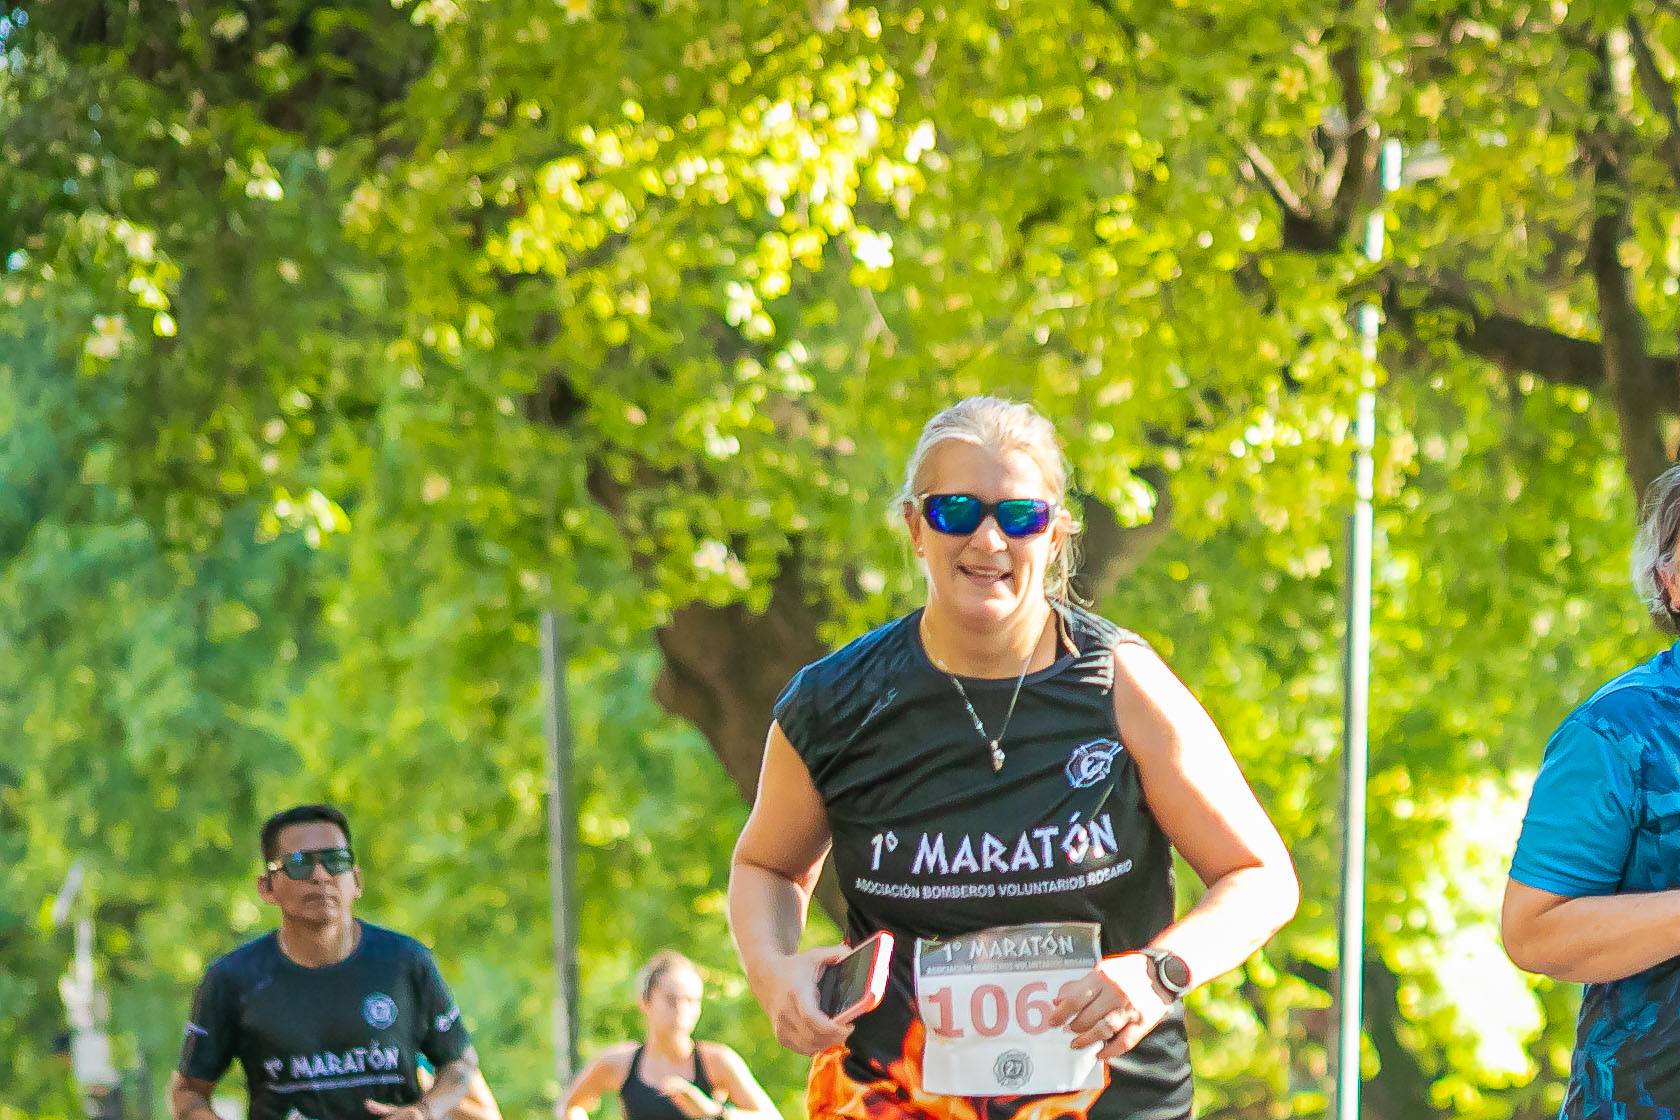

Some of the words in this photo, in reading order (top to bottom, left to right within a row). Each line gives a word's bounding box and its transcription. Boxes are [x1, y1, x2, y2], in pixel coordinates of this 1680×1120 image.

[911, 810, 1119, 875] MARATÓN
[922, 883, 996, 900] BOMBEROS
[998, 874, 1085, 897] VOLUNTARIOS
[1086, 858, 1133, 887] ROSARIO
[969, 930, 1074, 960] MARATÓN
[928, 981, 1070, 1039] 106
